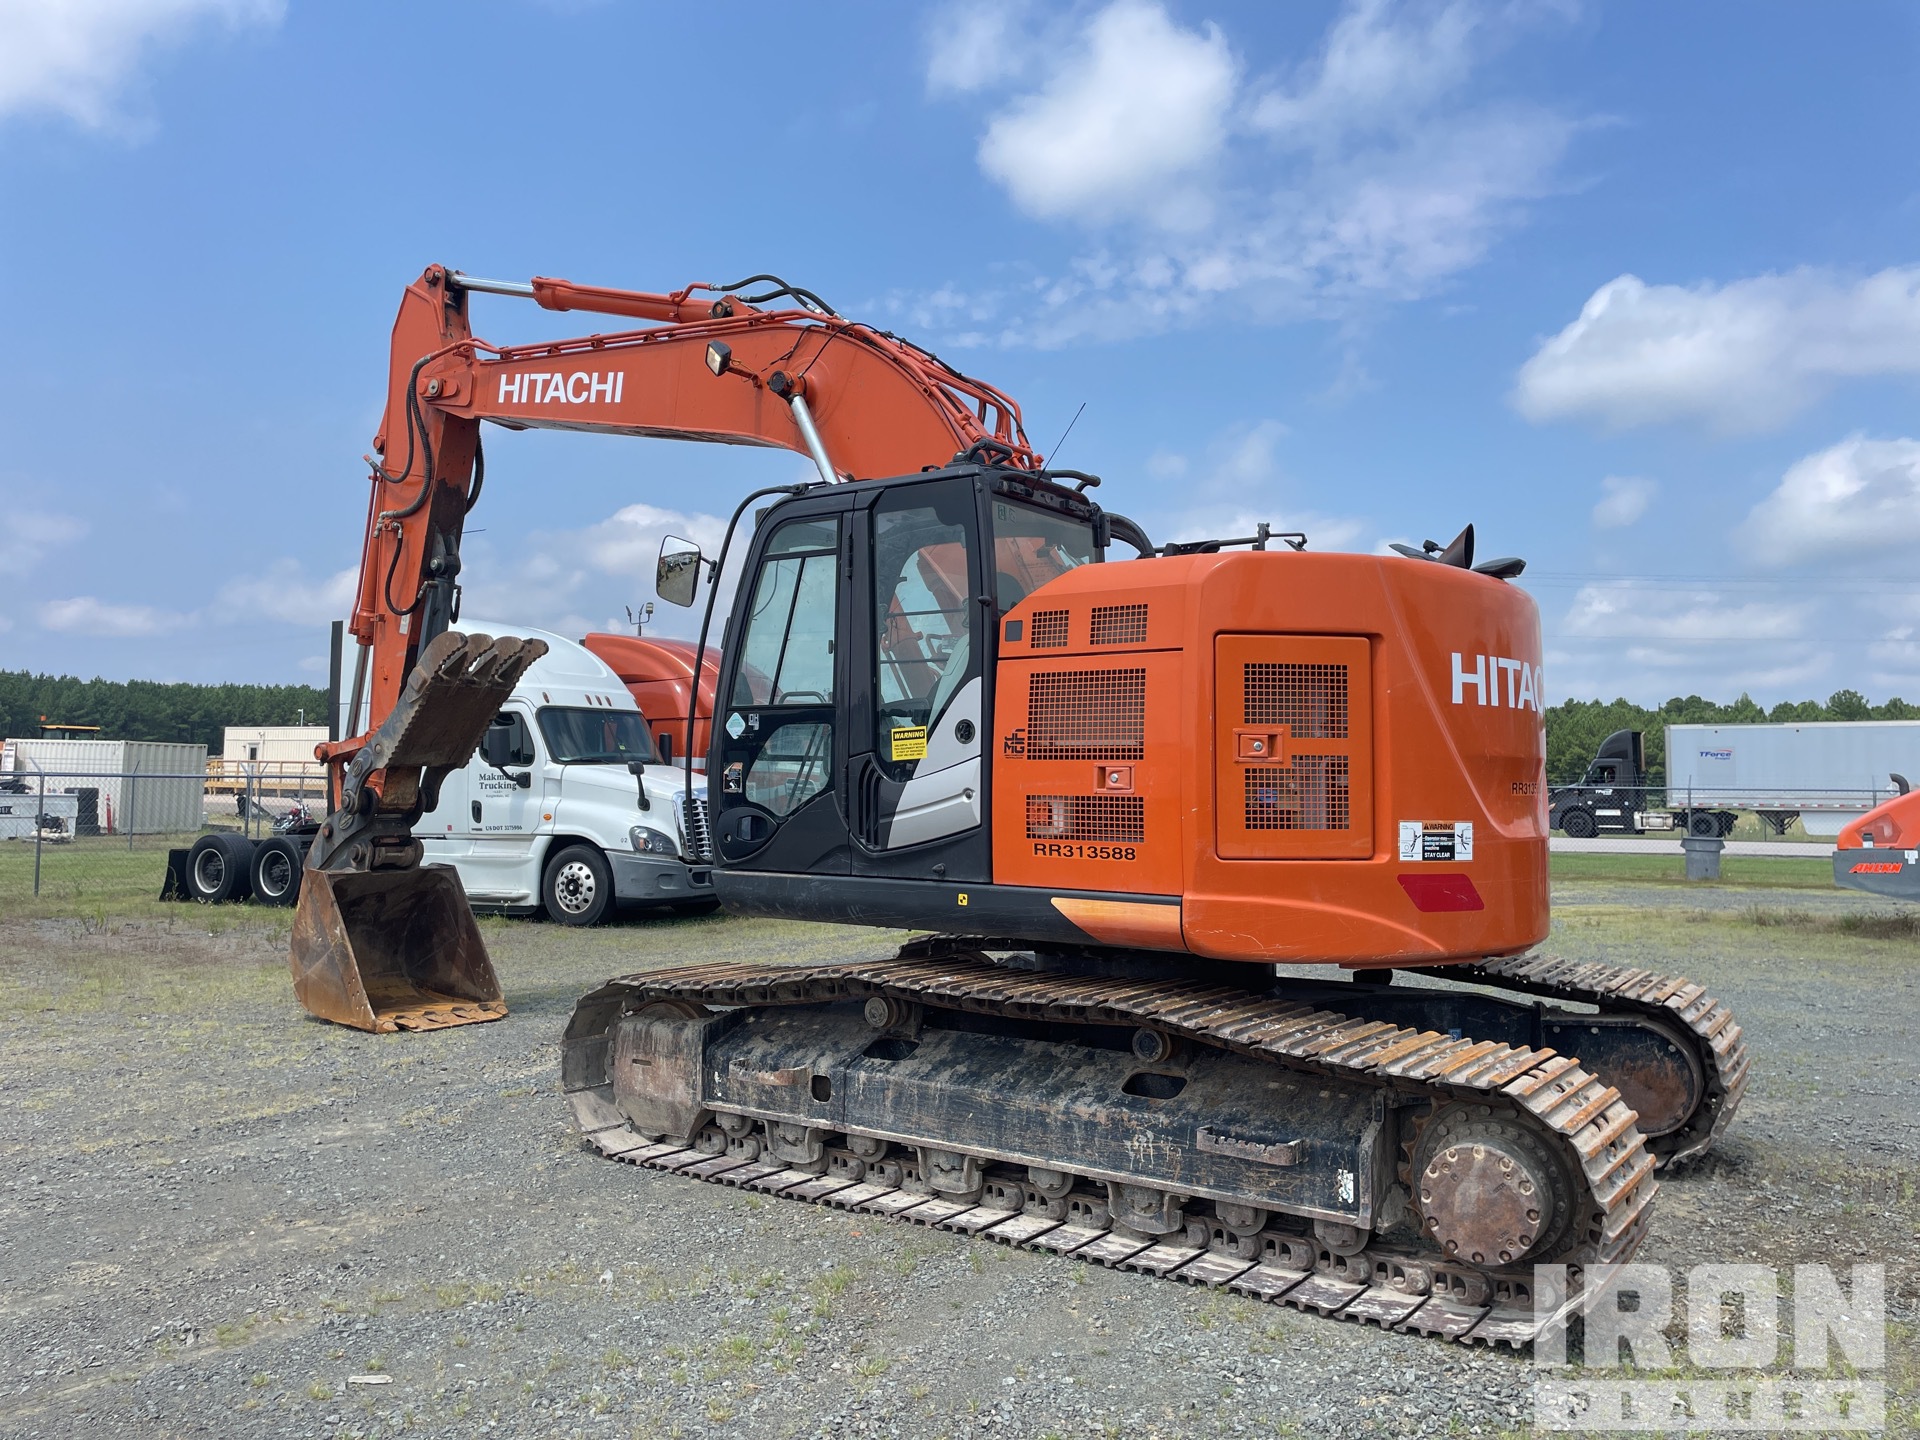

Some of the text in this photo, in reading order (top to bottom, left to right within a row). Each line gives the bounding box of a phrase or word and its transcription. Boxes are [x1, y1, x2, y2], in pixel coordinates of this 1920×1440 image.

[498, 371, 624, 404] HITACHI
[894, 731, 924, 740] WARNING
[479, 781, 517, 791] Trucking
[1034, 843, 1136, 860] RR313588
[1849, 862, 1903, 873] AHERN
